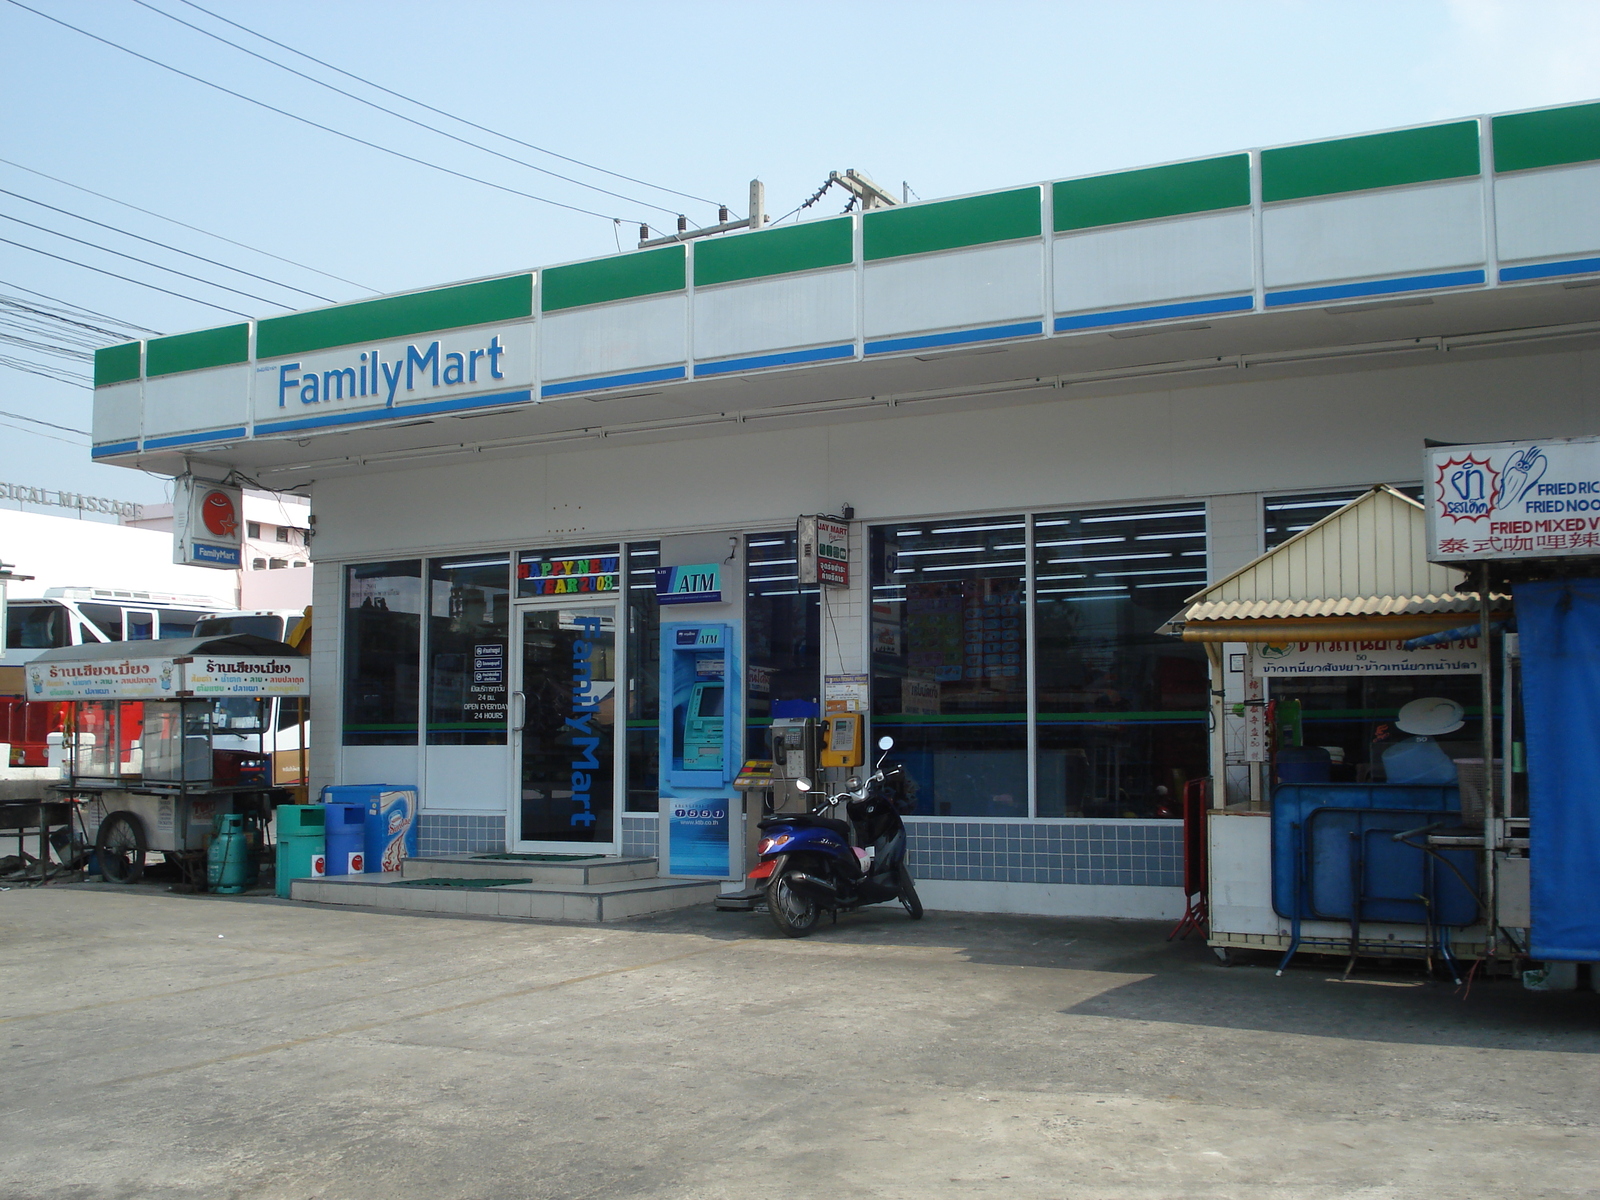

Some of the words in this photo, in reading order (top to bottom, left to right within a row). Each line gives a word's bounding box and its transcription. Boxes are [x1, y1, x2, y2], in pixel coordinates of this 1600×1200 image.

[279, 334, 505, 408] FamilyMart
[1537, 482, 1577, 496] FRIED
[1579, 481, 1600, 494] RIC
[0, 482, 52, 505] SICAL
[58, 490, 144, 519] MASSAGE
[1526, 500, 1565, 513] FRIED
[1566, 499, 1600, 512] NOO
[817, 522, 829, 531] JAY
[830, 525, 848, 535] MART
[1490, 521, 1533, 534] FRIED
[1535, 518, 1586, 533] MIXED
[199, 548, 235, 560] FamilyMart
[517, 560, 574, 579] HAPPY
[577, 558, 617, 573] NEW
[533, 578, 578, 595] YEAR
[580, 575, 613, 592] 2008
[678, 573, 715, 593] ATM
[699, 634, 718, 644] ATM
[480, 702, 508, 710] EVERYDAY
[565, 617, 600, 826] FamilyMart
[675, 809, 723, 818] 1551
